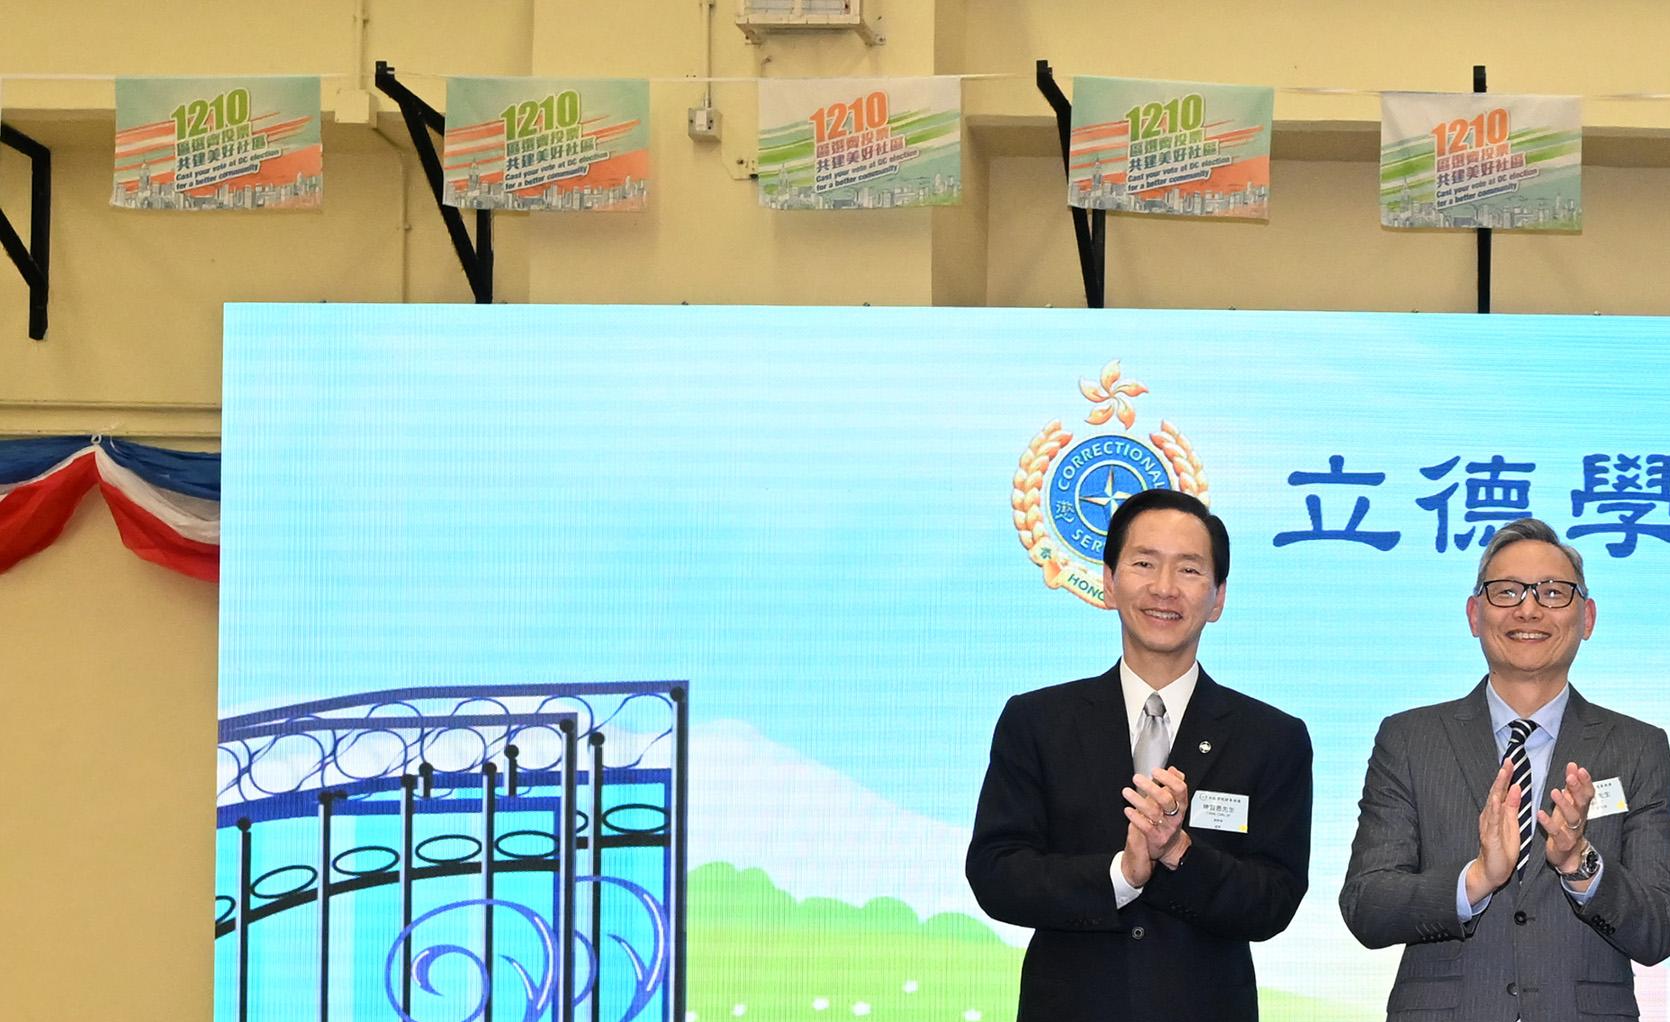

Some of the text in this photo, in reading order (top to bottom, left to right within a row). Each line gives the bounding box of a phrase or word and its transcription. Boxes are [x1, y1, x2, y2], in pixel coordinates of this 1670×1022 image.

[170, 88, 249, 141] 1210
[500, 90, 578, 141] 1210
[810, 92, 887, 143] 1210
[1125, 93, 1202, 142] 1210
[1431, 107, 1508, 158] 1210
[1058, 441, 1165, 491] CORRECTIONAL
[1071, 528, 1104, 553] SER
